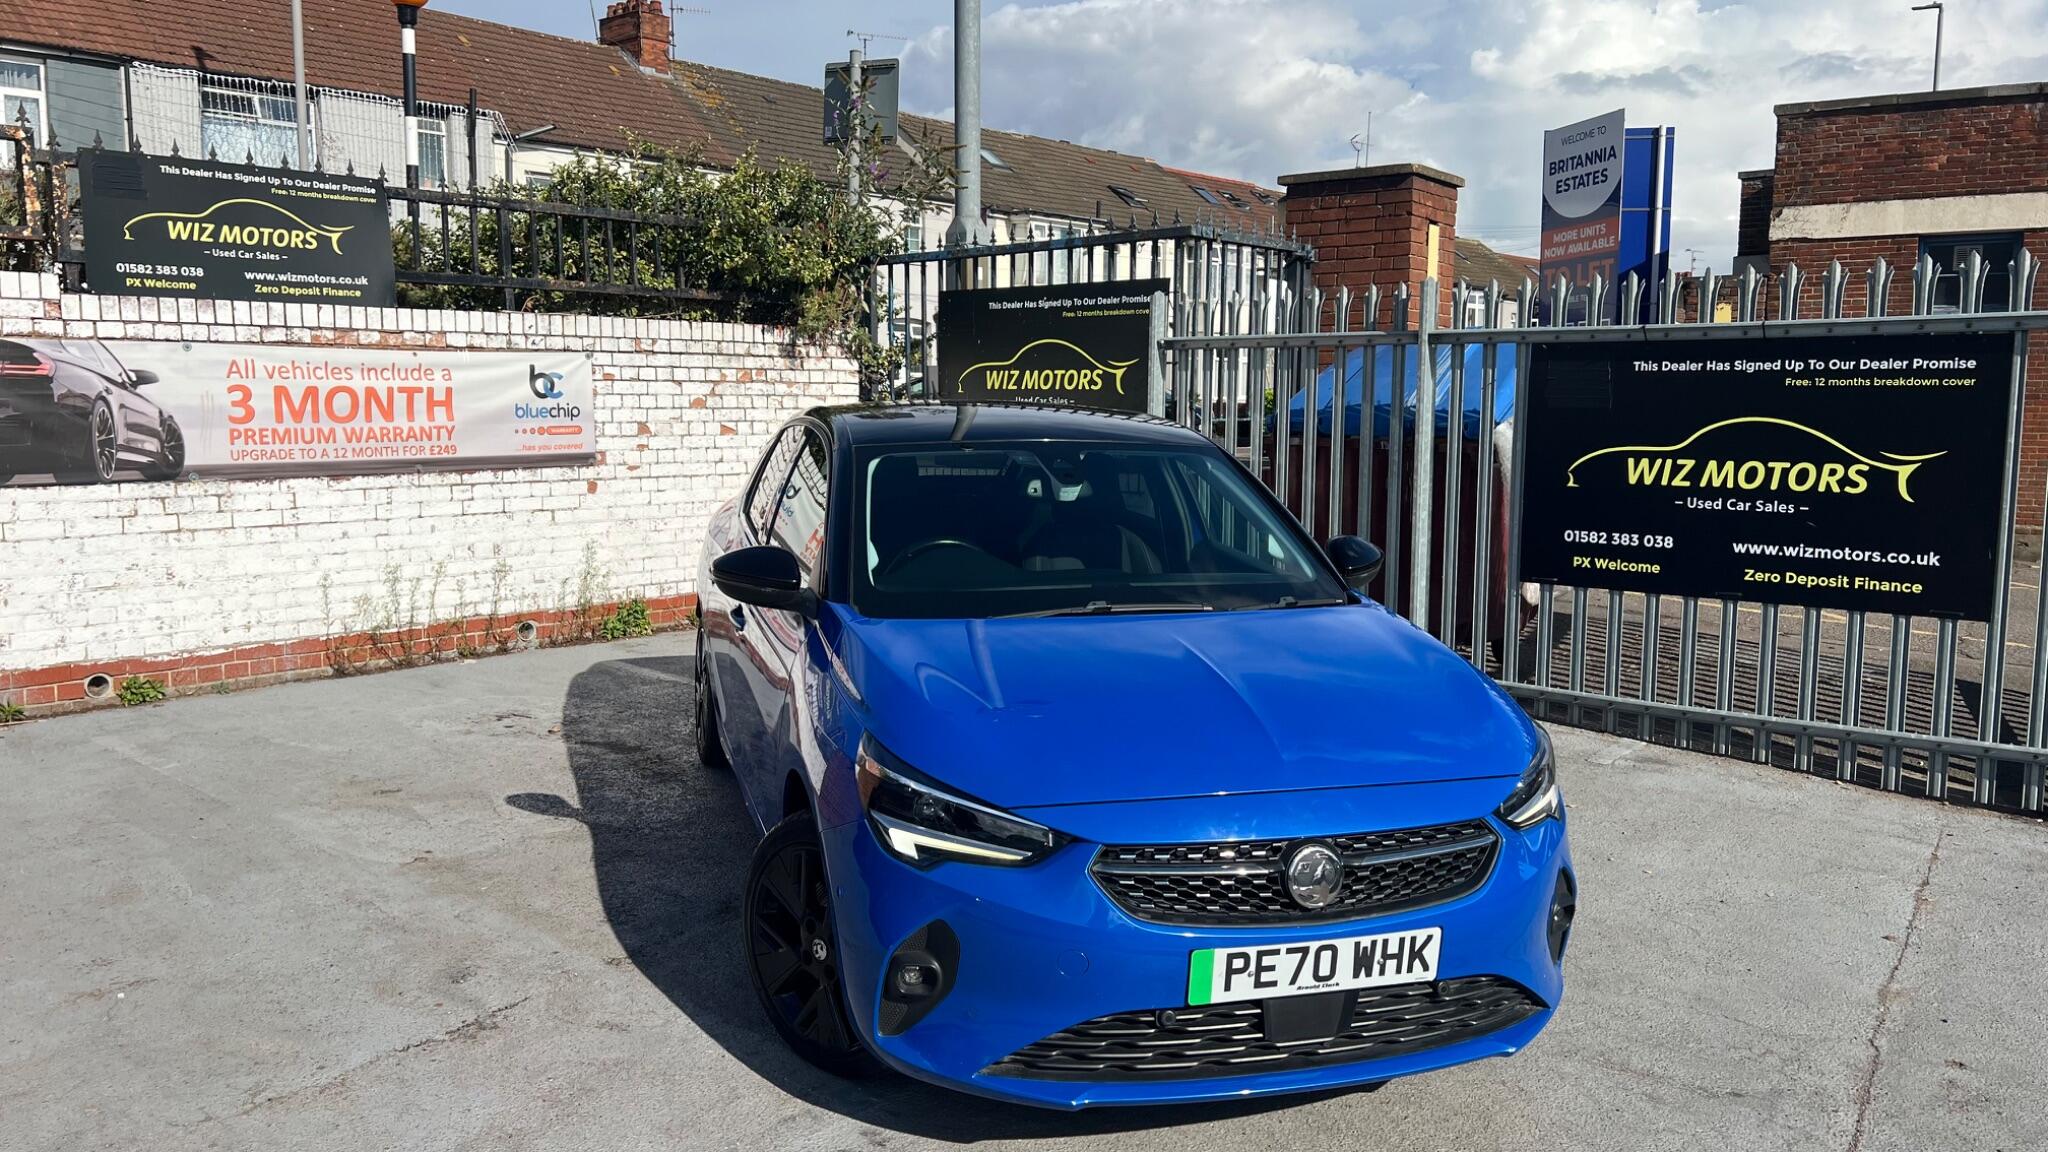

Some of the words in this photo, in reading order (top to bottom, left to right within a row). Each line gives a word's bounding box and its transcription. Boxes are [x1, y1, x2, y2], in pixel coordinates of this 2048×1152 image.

[1561, 128, 1595, 146] WELCOME
[1597, 125, 1606, 135] TO
[1549, 145, 1617, 176] BRITANNIA
[160, 165, 180, 175] This
[182, 167, 213, 178] Dealer
[215, 171, 233, 180] Has
[234, 172, 265, 183] Signed
[267, 176, 280, 186] Up
[282, 177, 293, 186] To
[295, 179, 311, 188] Our
[313, 181, 340, 191] Dealer
[342, 184, 376, 194] Promise
[1556, 168, 1608, 194] ESTATES
[297, 191, 322, 199] months
[323, 193, 358, 202] breakdown
[167, 220, 215, 243] WIZ
[218, 224, 318, 250] MOTORS
[1553, 229, 1578, 244] MORE
[1580, 223, 1606, 238] UNITS
[212, 248, 236, 258] Used
[238, 250, 254, 259] Car
[256, 251, 280, 261] Sales
[1544, 244, 1566, 259] NOW
[1567, 236, 1615, 254] AVAILABLE
[116, 262, 153, 274] 01582
[155, 265, 178, 275] 383
[181, 266, 204, 277] 038
[244, 271, 368, 285] www.wizmotors.co.uk
[125, 277, 142, 287] PX
[144, 279, 196, 290] Welcome
[255, 284, 279, 293] Zero
[281, 285, 320, 296] Deposit
[323, 287, 361, 297] Finance
[988, 302, 1001, 310] This
[1002, 300, 1023, 309] Dealer
[1025, 300, 1037, 308] Has
[1038, 298, 1061, 309] Signed
[1062, 299, 1072, 308] Up
[1074, 298, 1082, 306] To
[1083, 297, 1096, 305] Our
[1097, 296, 1120, 305] Dealer
[1104, 308, 1135, 316] breakdown
[226, 358, 256, 379] All
[263, 360, 353, 381] vehicles
[361, 362, 435, 381] include
[438, 368, 452, 381] a
[1633, 361, 1658, 371] This
[1662, 360, 1703, 371] Dealer
[1706, 360, 1730, 371] Has
[1734, 359, 1781, 373] Signed
[1785, 360, 1804, 373] Up
[1808, 359, 1825, 370] To
[1828, 359, 1856, 370] Our
[1860, 358, 1909, 369] Dealer
[1913, 357, 1977, 369] Promise
[986, 370, 1020, 390] WIZ
[1021, 369, 1103, 390] MOTORS
[1785, 377, 1812, 386] Free:
[1814, 378, 1825, 386] 12
[1828, 377, 1871, 386] months
[1874, 376, 1939, 386] breakdown
[1942, 378, 1976, 386] cover
[226, 384, 256, 425] 3
[273, 385, 455, 424] MONTH
[515, 402, 581, 421] bluechip
[228, 427, 337, 446] PREMIUM
[342, 425, 456, 444] WARRANTY
[230, 448, 296, 462] UPGRADE
[298, 448, 317, 459] TO
[320, 448, 330, 459] A
[333, 447, 348, 459] 12
[352, 446, 399, 458] MONTH
[402, 445, 426, 457] FOR
[429, 444, 457, 456] £249
[553, 442, 583, 450] covered
[1627, 457, 1696, 487] WIZ
[1699, 460, 1870, 494] MOTORS
[1687, 497, 1722, 510] Used
[1726, 498, 1751, 511] Car
[1755, 500, 1795, 513] Sales
[1564, 530, 1607, 545] 01582
[1611, 533, 1639, 546] 383
[1643, 535, 1674, 548] 038
[1732, 542, 1940, 566] www.wizmotors.co.uk
[1573, 556, 1591, 568] PX
[1594, 558, 1661, 573] Welcome
[1743, 569, 1781, 583] Zero
[1785, 571, 1849, 588] Deposit
[1854, 577, 1923, 594] Finance
[1223, 943, 1339, 993] PE70
[1352, 934, 1434, 980] WHK
